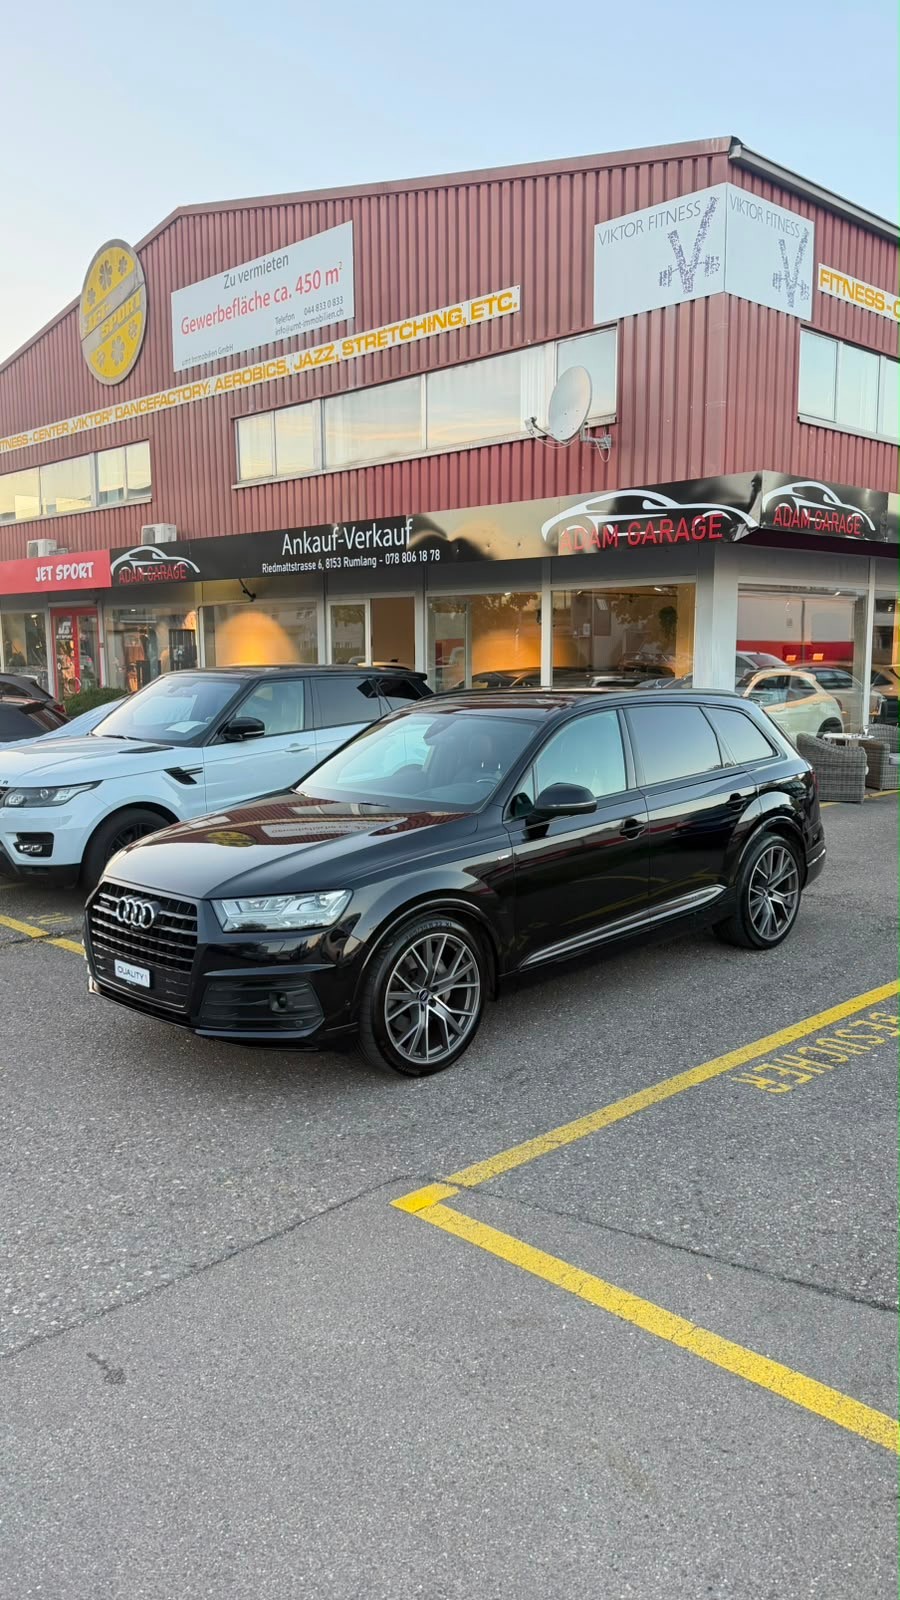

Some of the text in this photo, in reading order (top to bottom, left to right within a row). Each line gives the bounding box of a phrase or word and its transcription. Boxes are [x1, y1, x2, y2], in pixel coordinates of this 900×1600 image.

[598, 200, 701, 246] VIKTOR FITNESS
[729, 193, 800, 239] VIKTOR FITNESS
[223, 254, 289, 289] Zu vermieten
[181, 291, 270, 335] Gewerbefläche
[273, 286, 292, 303] ca.
[295, 270, 321, 294] 450
[294, 345, 339, 371] JAZZ,
[342, 308, 467, 356] STRETCHING,
[471, 292, 518, 321] ETC.
[281, 518, 414, 556] Ankauf-Verkauf
[560, 513, 723, 552] ADAM GARAGE
[773, 506, 861, 536] ADAM GARAGE
[35, 562, 94, 583] JET SPORT
[119, 564, 187, 584] ADAM GARAGE
[262, 561, 317, 574] Riedmattstrasse
[325, 557, 342, 569] 8153
[343, 555, 377, 569] Rumlang
[385, 552, 400, 565] 078
[402, 551, 417, 563] 806
[419, 549, 428, 562] 18
[430, 549, 441, 561] 78
